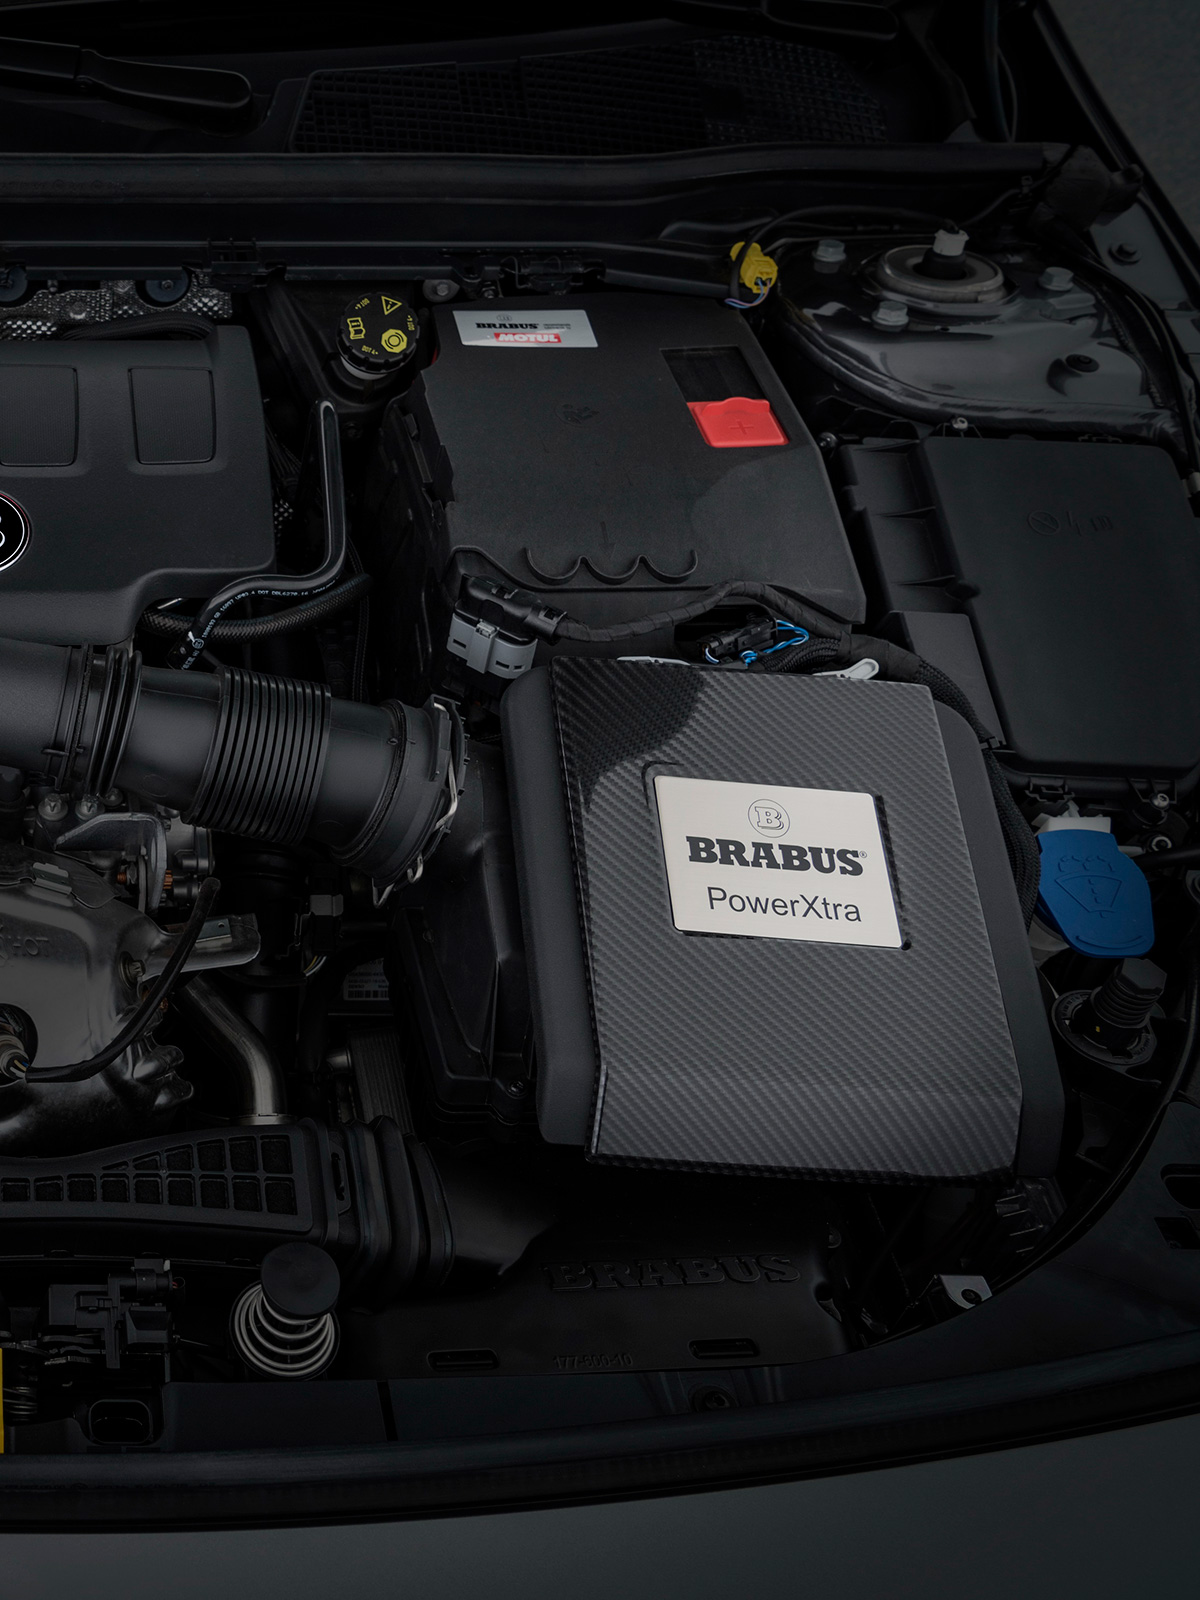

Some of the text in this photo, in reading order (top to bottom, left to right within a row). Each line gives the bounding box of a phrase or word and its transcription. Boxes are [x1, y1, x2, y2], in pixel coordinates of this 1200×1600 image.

[475, 322, 538, 330] BRABUS
[498, 333, 559, 343] MOTUL
[707, 886, 863, 923] PowerXtra
[540, 1254, 801, 1292] BRABUS
